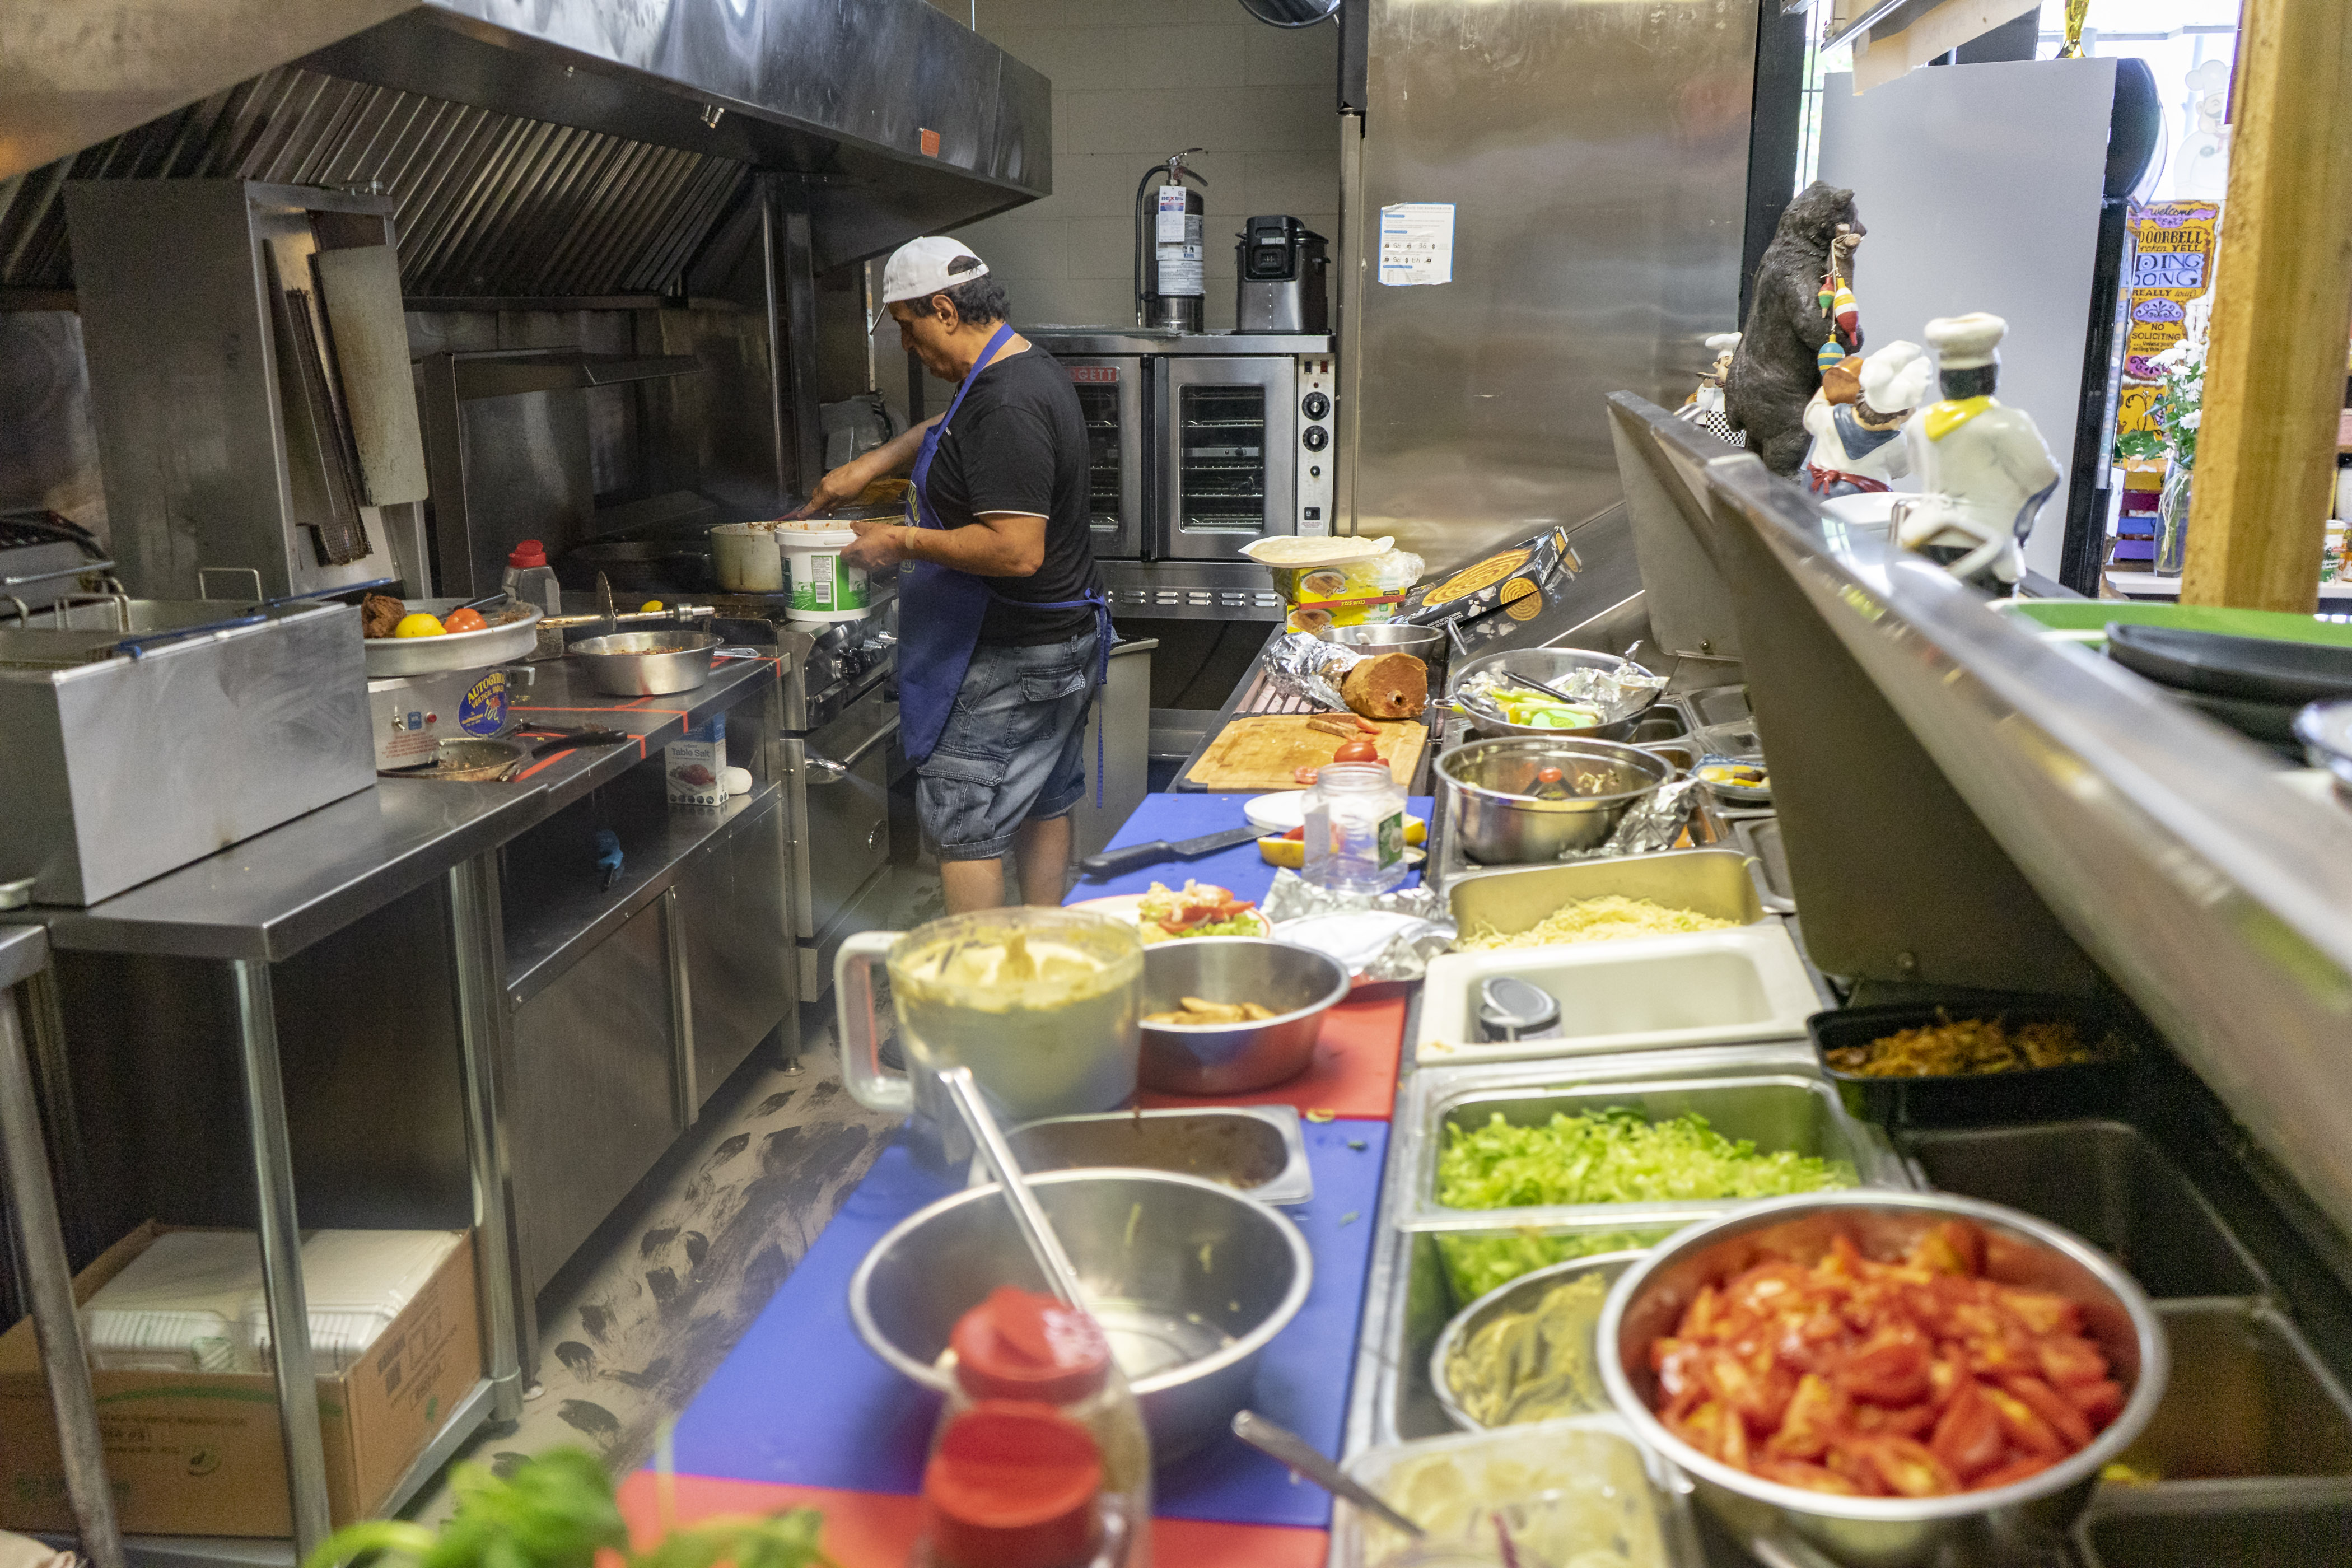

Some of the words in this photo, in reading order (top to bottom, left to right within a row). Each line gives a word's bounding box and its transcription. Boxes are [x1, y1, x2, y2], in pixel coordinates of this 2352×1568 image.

[2152, 204, 2194, 216] welcome
[2139, 230, 2203, 244] DOORBELL
[2136, 254, 2201, 272] DING
[2131, 332, 2181, 340] SOLICITING
[671, 748, 693, 756] Table
[694, 749, 710, 758] Salt
